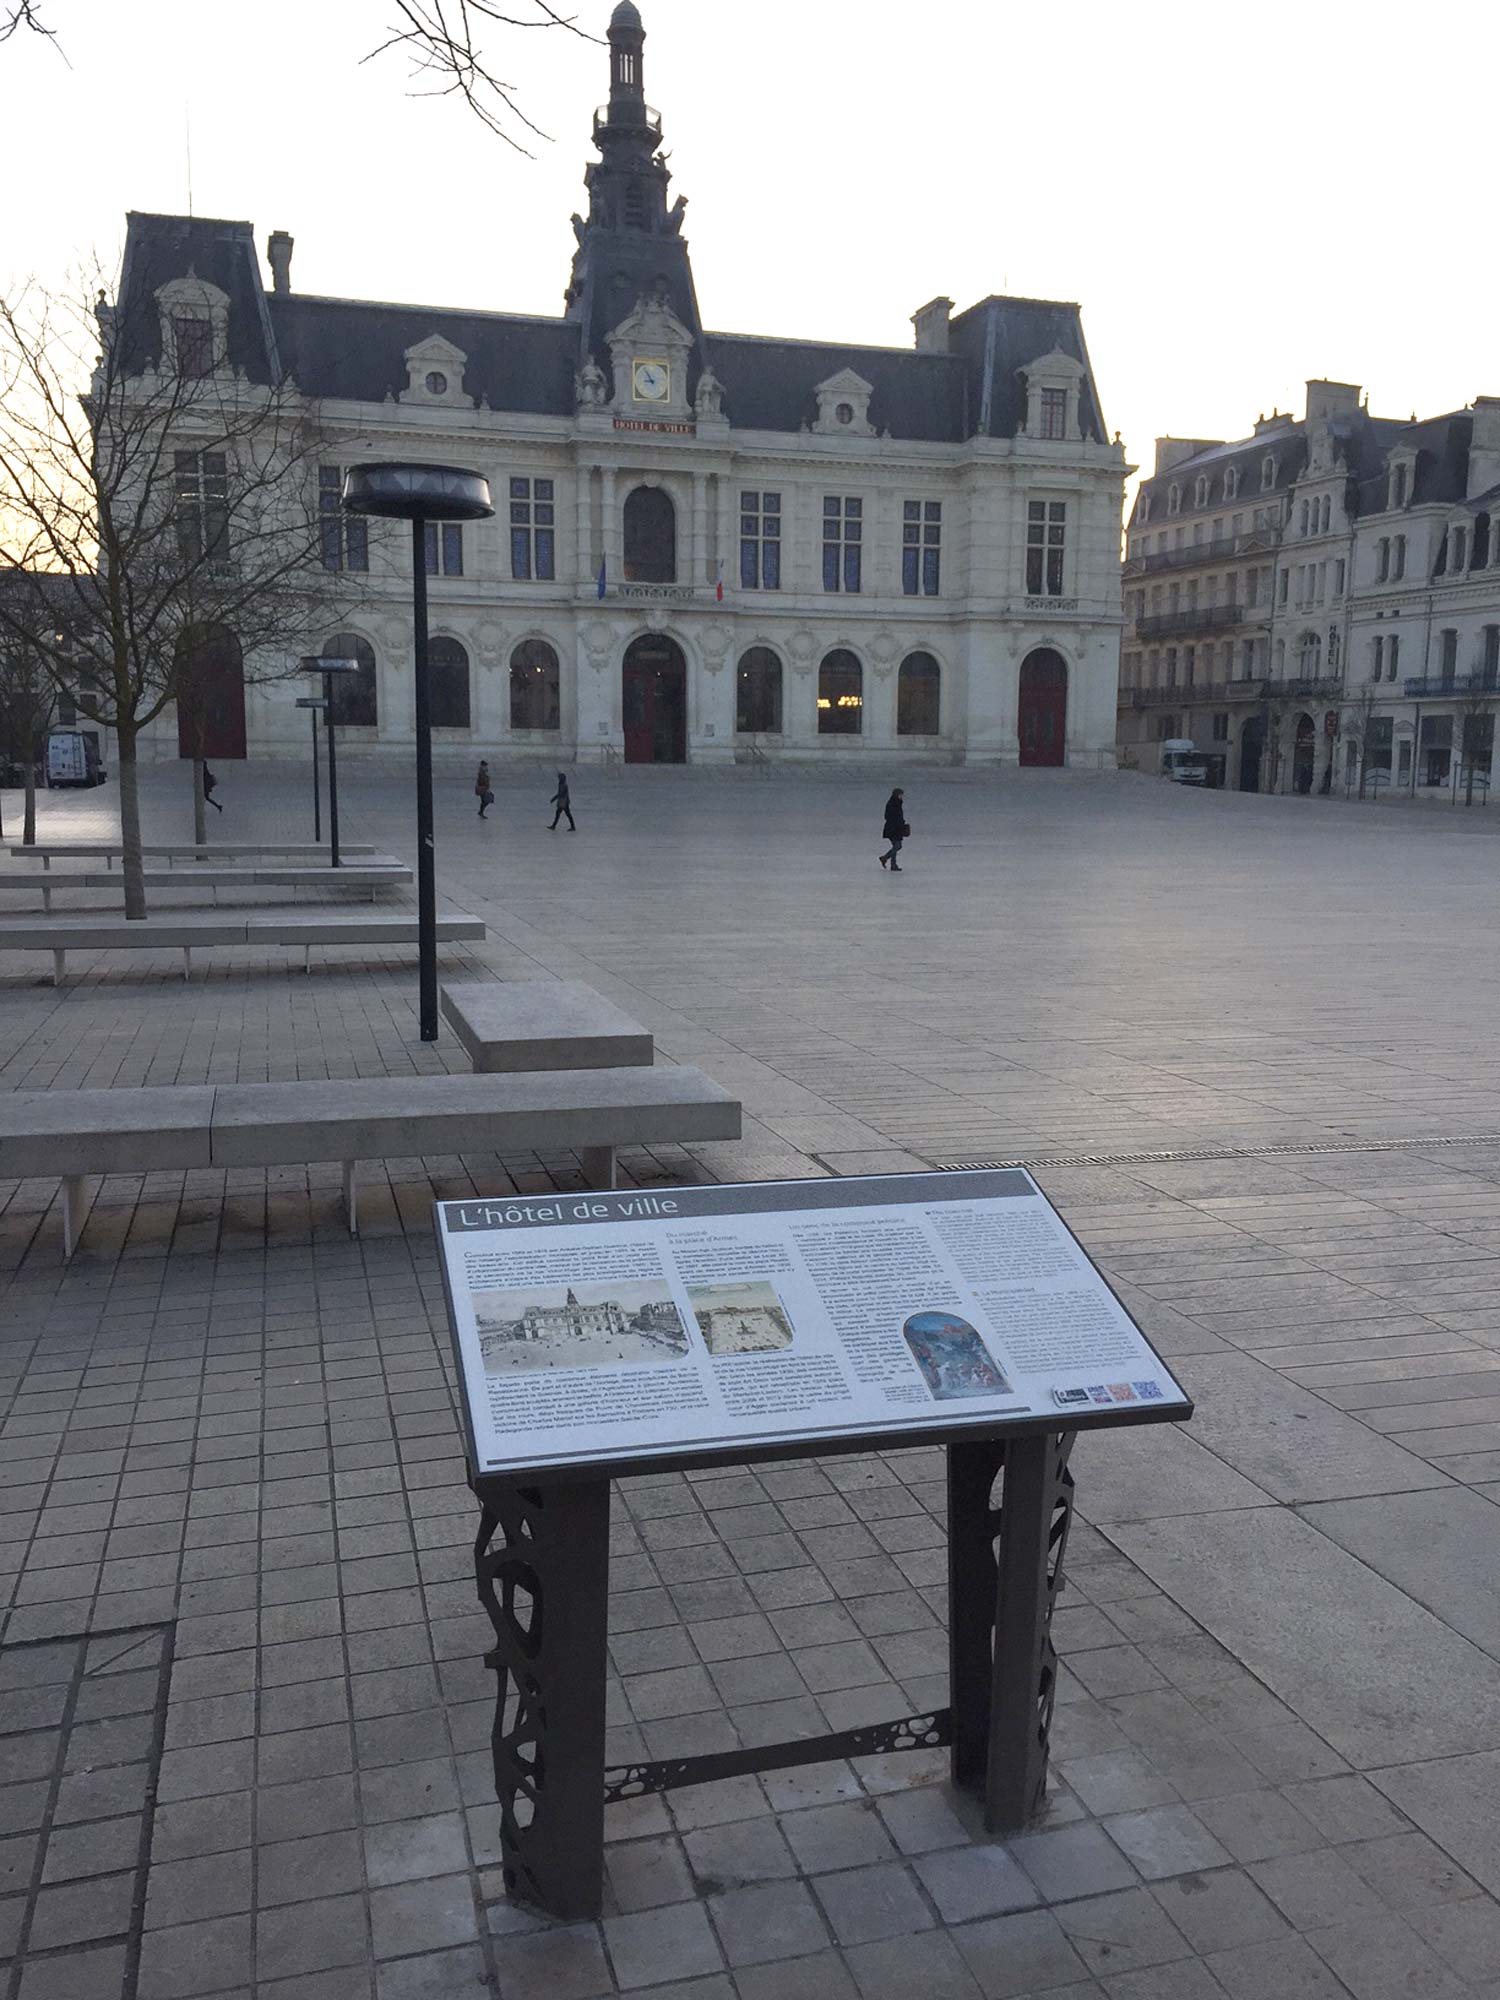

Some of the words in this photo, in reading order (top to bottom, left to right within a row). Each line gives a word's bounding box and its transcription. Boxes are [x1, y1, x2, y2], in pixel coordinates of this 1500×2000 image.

[460, 1203, 563, 1226] L'hôtel
[573, 1202, 609, 1219] de
[617, 1198, 679, 1217] ville
